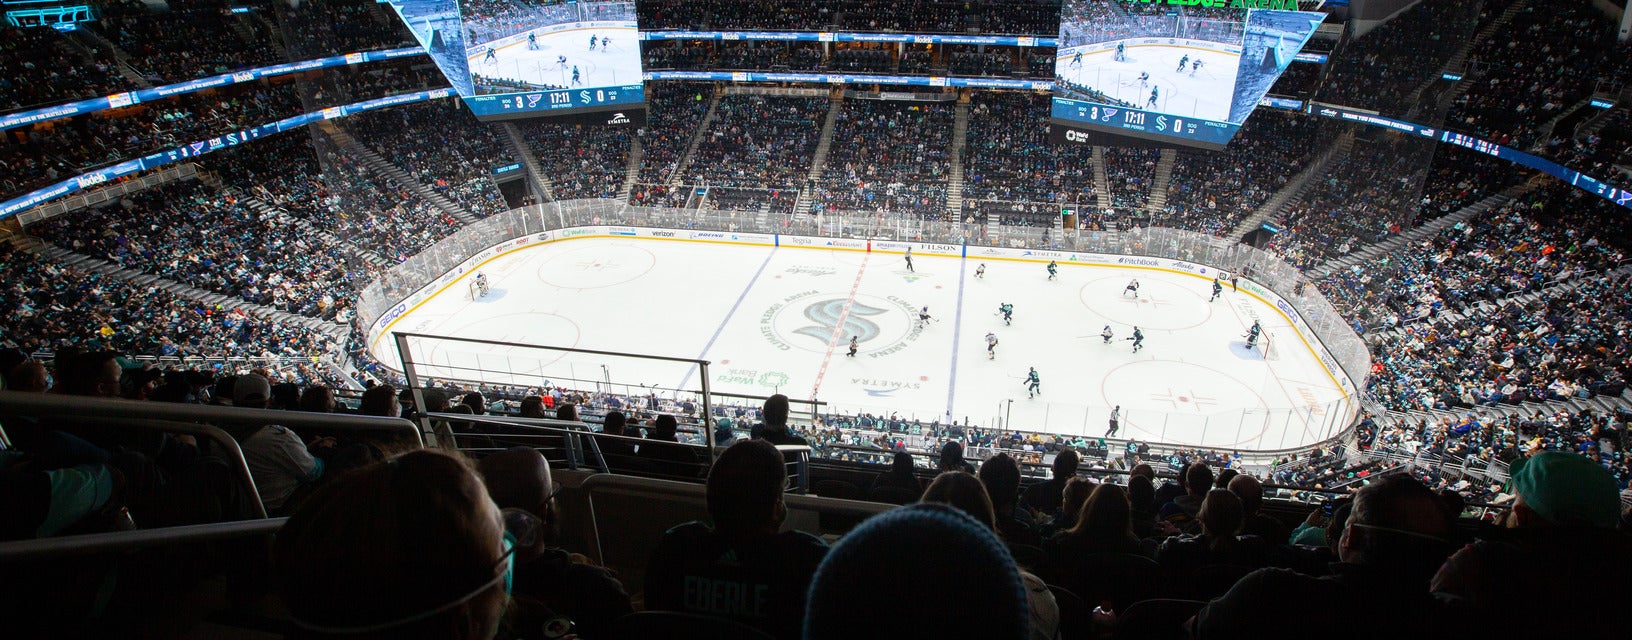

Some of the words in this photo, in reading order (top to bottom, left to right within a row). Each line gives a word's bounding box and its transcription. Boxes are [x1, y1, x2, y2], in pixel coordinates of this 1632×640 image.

[515, 96, 523, 109] 3
[550, 91, 570, 104] 17:11
[596, 90, 604, 102] 0
[1090, 106, 1098, 120] 3
[1125, 111, 1145, 125] 17:11
[1173, 119, 1182, 133] 0
[78, 172, 107, 189] Modelo
[921, 243, 956, 251] FILSON
[1124, 257, 1159, 267] PitchBook
[380, 303, 407, 329] GEICO
[1276, 300, 1299, 324] GEICO
[760, 326, 791, 351] CLIMATE
[784, 289, 820, 302] ARENA
[868, 342, 908, 358] ARENA
[716, 373, 755, 386] WaFd
[727, 367, 758, 378] Bank
[851, 377, 921, 390] SYMETRA
[683, 575, 769, 617] EBERLE
